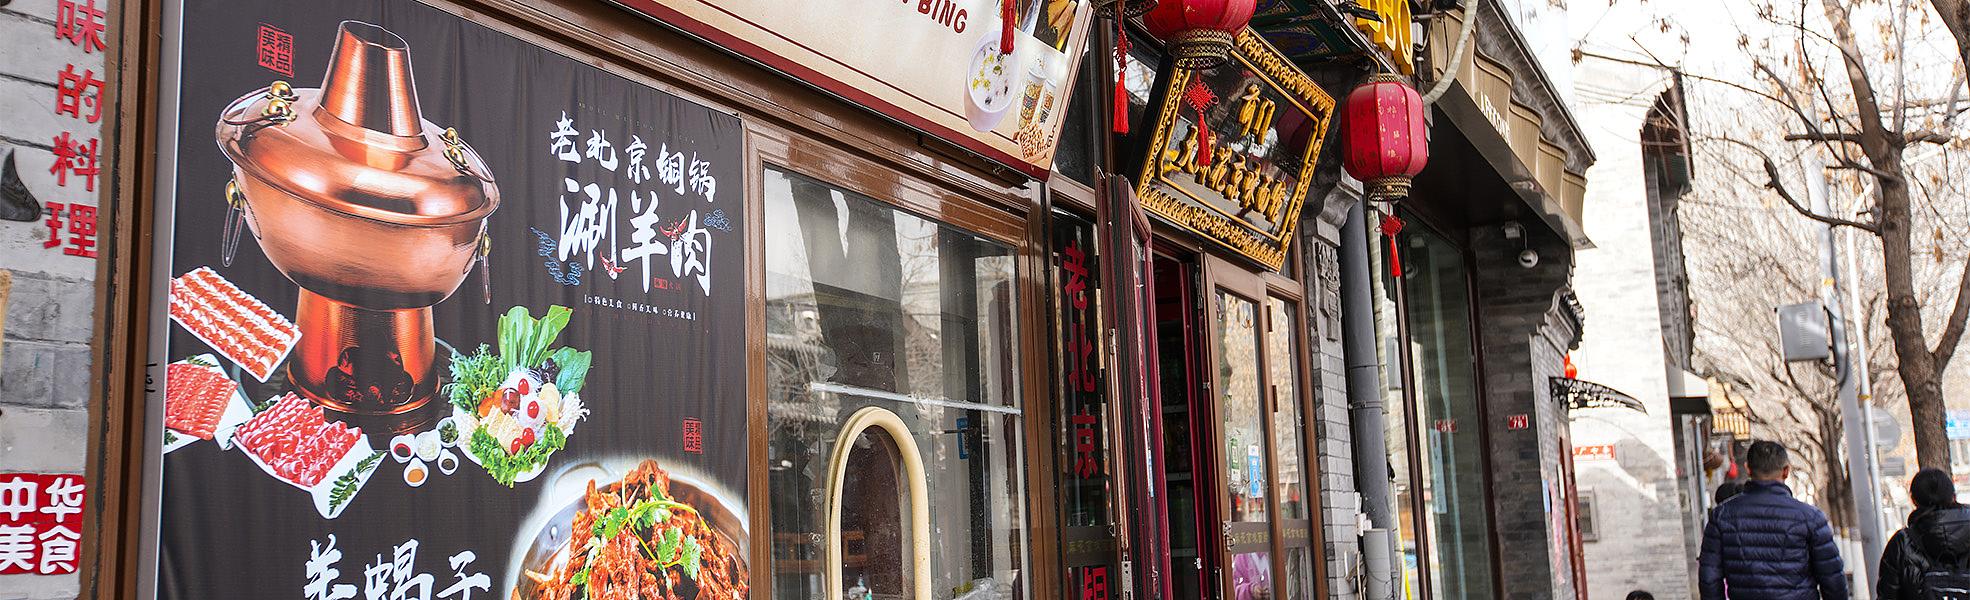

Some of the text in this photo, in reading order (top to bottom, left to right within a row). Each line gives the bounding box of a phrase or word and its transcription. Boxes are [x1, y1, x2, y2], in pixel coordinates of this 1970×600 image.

[918, 0, 968, 34] BING
[550, 110, 717, 203] 老北京铜锅
[558, 177, 713, 297] 涮羊肉
[0, 476, 86, 523] 中华
[0, 523, 81, 574] 美食
